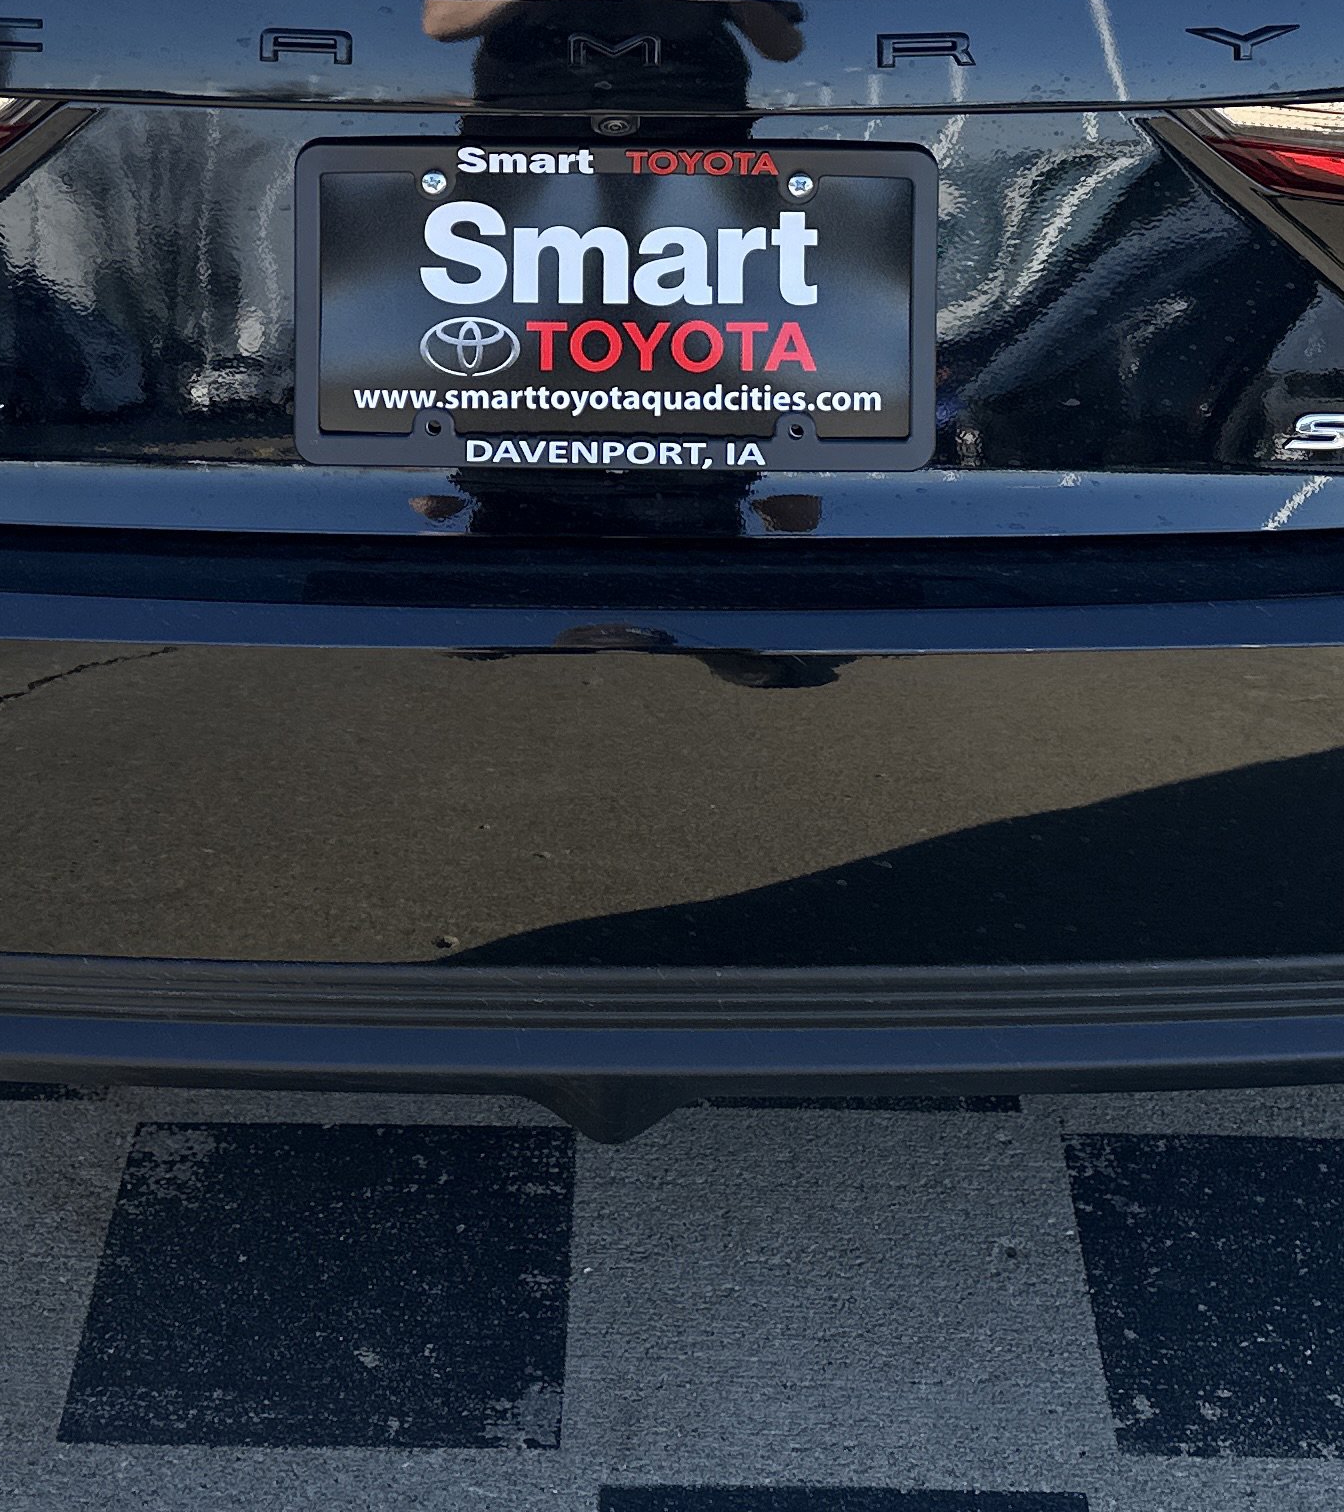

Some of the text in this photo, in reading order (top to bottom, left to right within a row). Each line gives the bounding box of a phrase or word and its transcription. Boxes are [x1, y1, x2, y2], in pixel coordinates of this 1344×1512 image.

[457, 146, 780, 176] Smart TOYOTA
[419, 200, 819, 307] Smart
[526, 320, 817, 373] TOYOTA
[353, 384, 882, 417] www.smarttoyotaquadcities.com
[465, 439, 766, 470] DAVENPORT, IA
